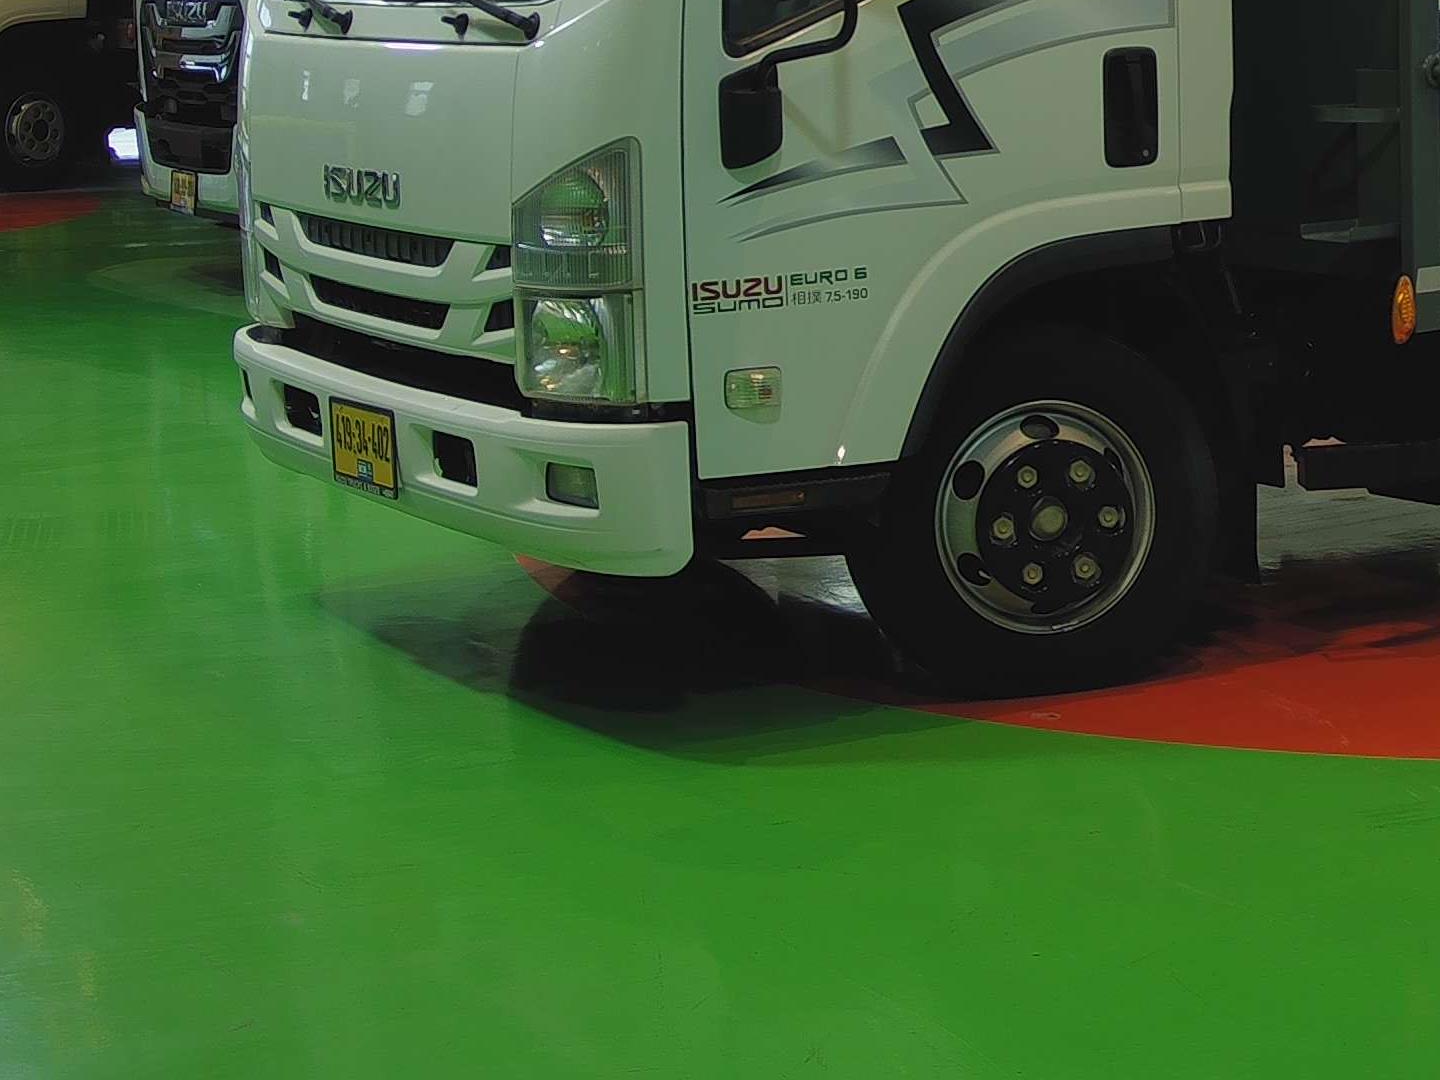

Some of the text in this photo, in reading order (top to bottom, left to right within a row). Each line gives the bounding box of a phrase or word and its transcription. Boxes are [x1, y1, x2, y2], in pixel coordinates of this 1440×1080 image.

[323, 163, 401, 210] ISUZU
[790, 267, 867, 286] EURO 6
[692, 275, 783, 302] ISUZU
[825, 287, 868, 304] 7.5-190
[693, 296, 784, 315] SUMO
